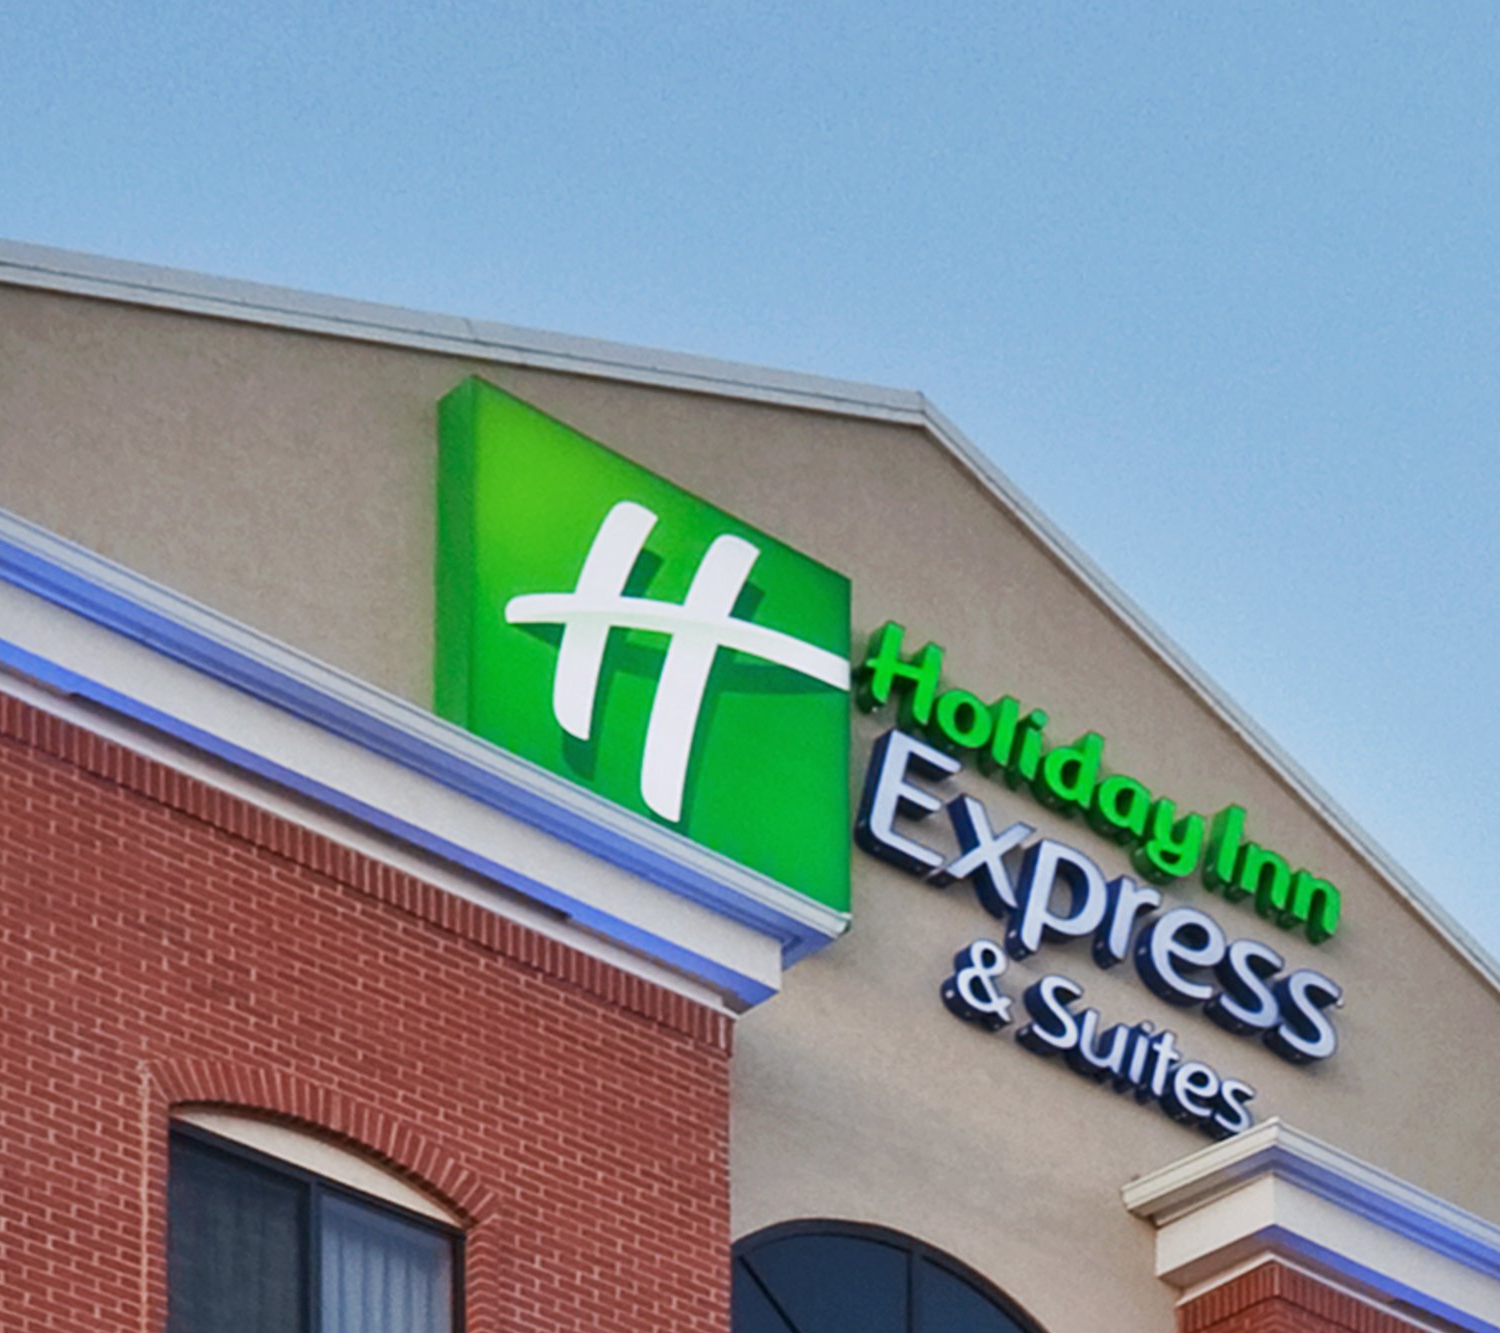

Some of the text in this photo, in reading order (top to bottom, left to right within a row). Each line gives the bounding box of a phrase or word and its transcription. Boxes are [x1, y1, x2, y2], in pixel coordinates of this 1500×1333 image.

[861, 619, 1342, 940] Holiday Inn
[861, 728, 1344, 1062] Express
[944, 937, 1256, 1135] & Suites
